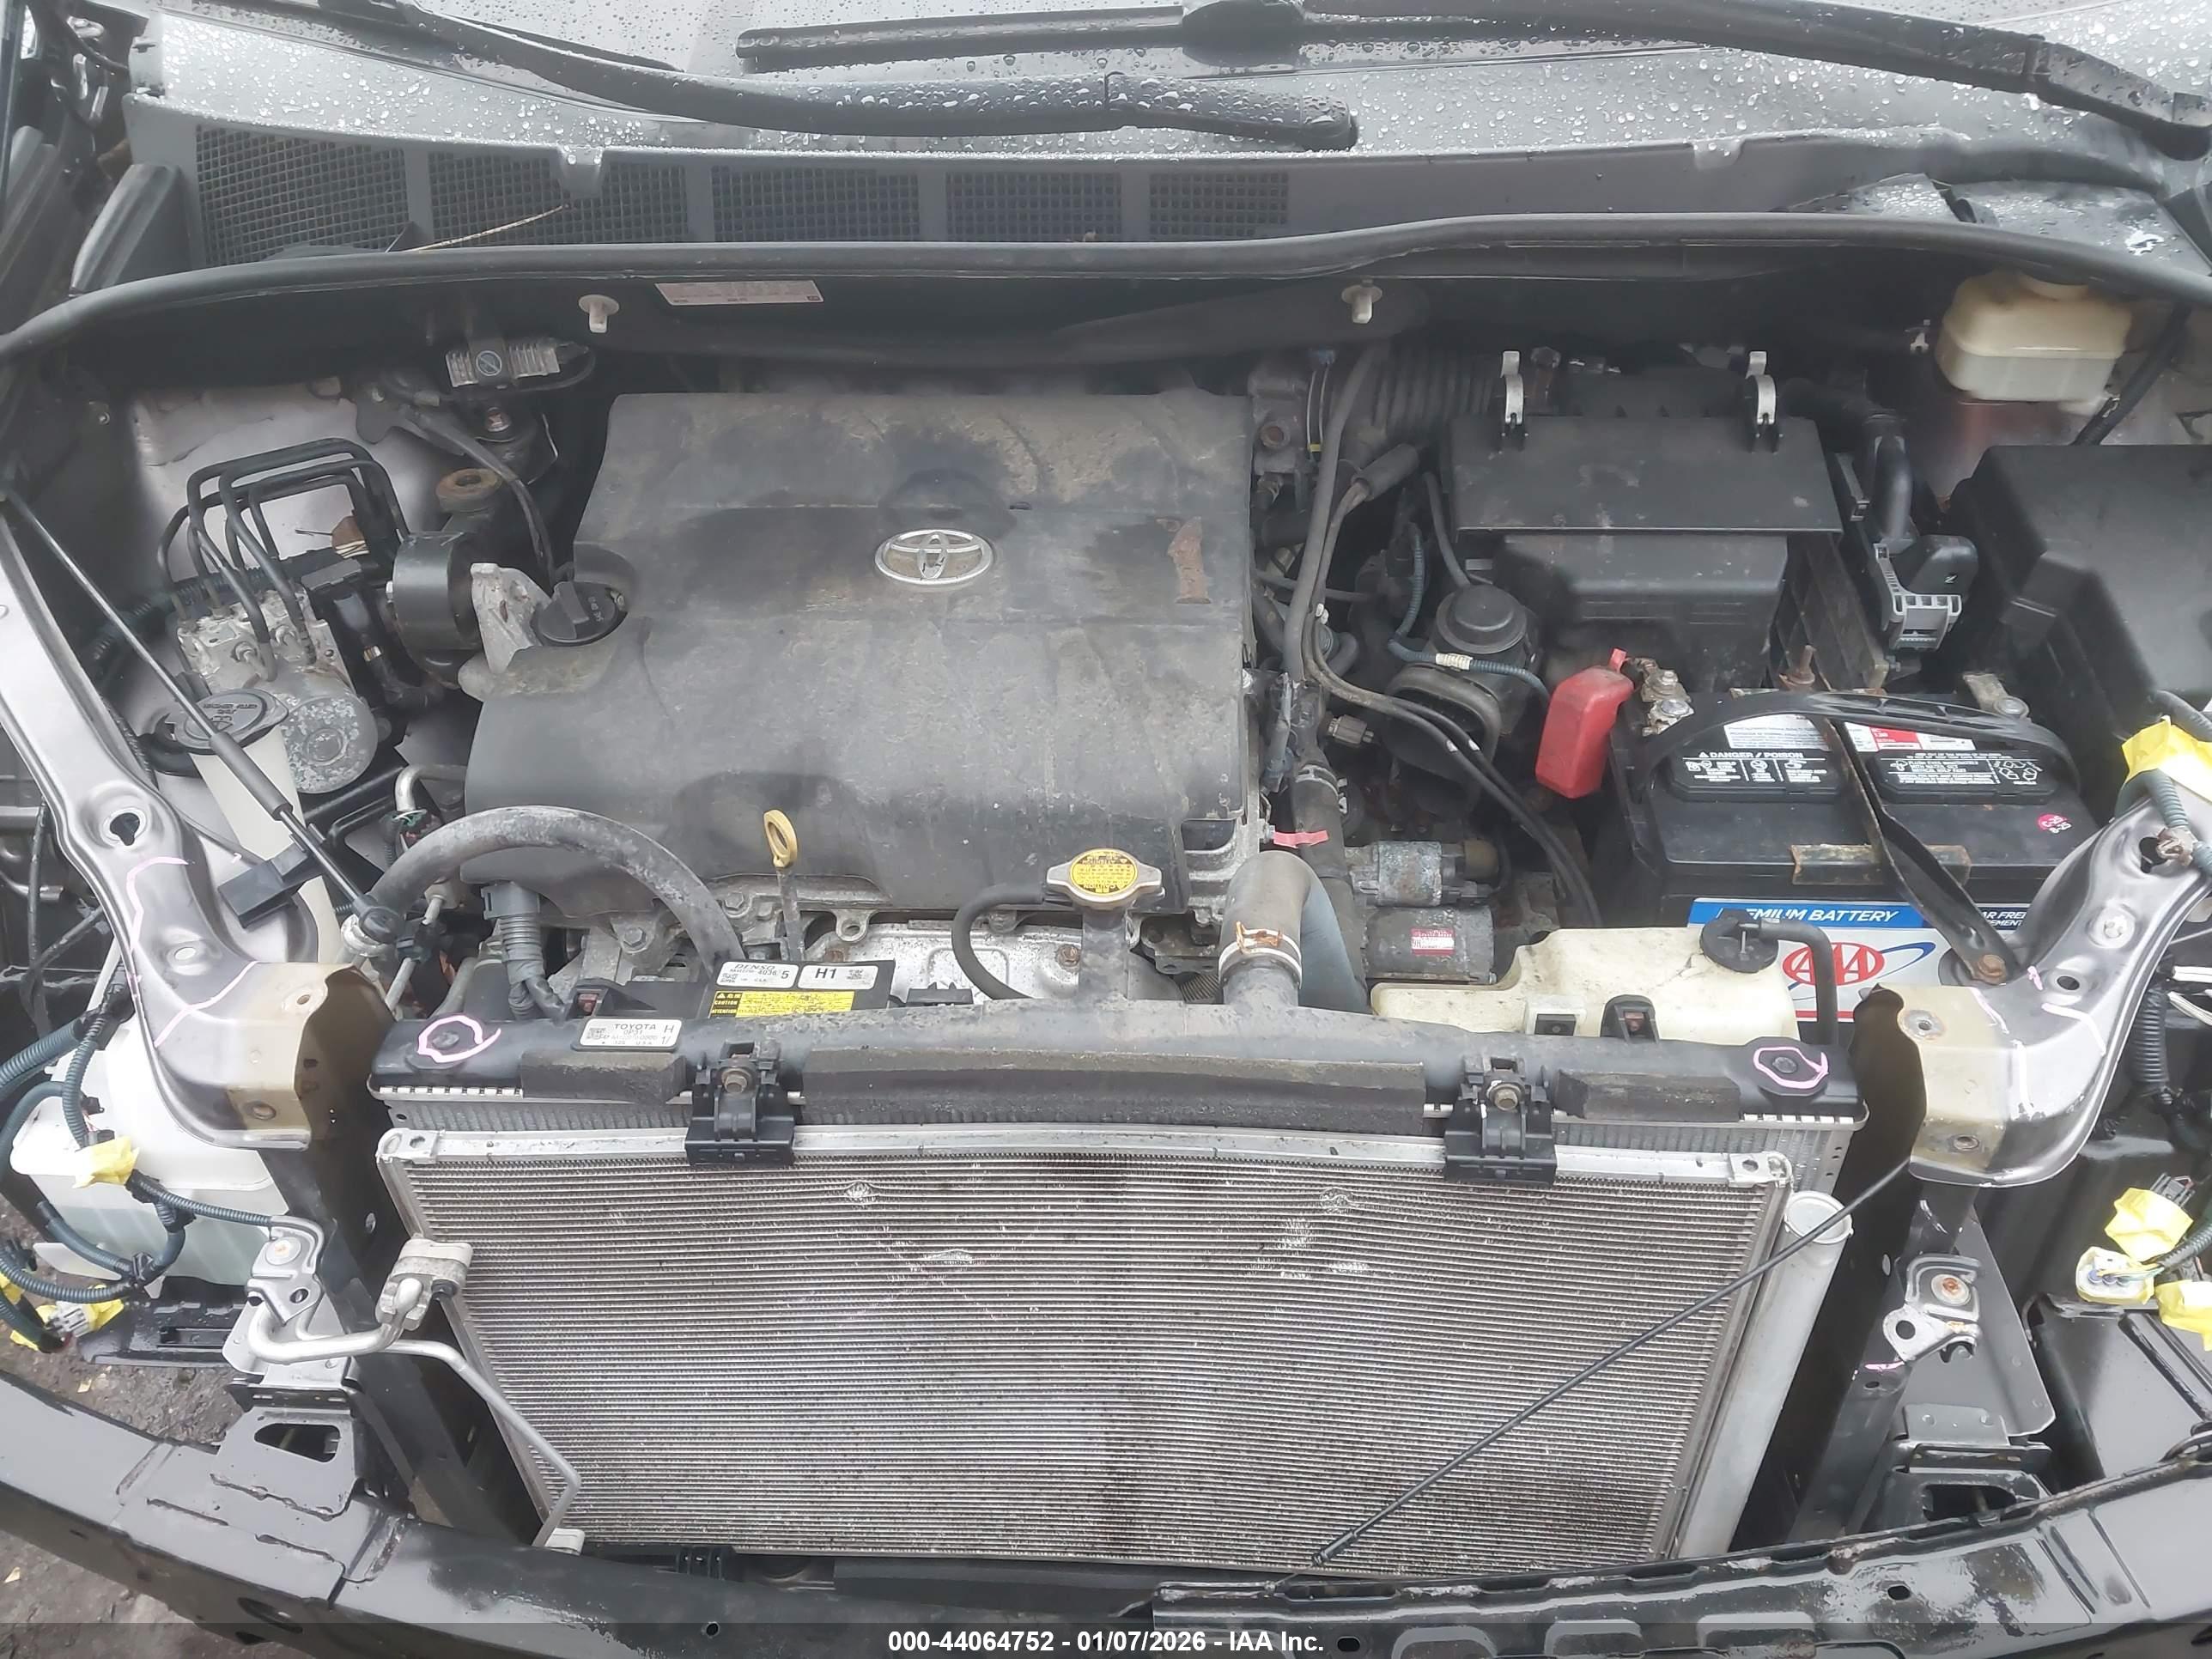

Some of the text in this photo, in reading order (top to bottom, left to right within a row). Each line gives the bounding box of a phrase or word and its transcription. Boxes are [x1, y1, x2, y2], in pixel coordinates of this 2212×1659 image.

[1808, 908, 1899, 922] BATTERY
[780, 970, 791, 980] 5
[814, 967, 838, 980] H1
[663, 1024, 675, 1034] H
